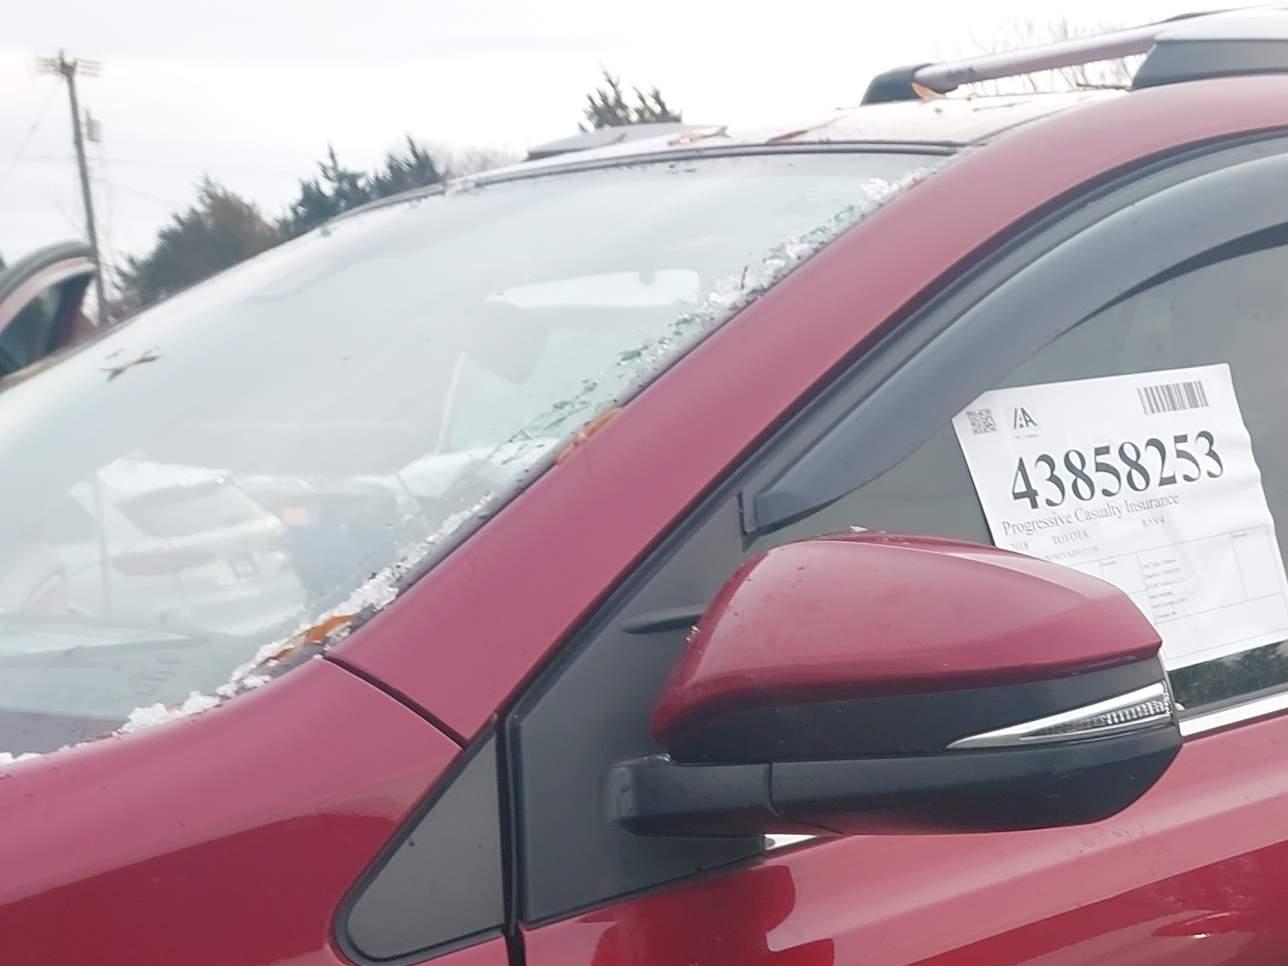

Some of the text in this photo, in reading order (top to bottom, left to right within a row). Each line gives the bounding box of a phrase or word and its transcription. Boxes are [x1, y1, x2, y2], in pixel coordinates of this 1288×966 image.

[1012, 431, 1223, 510] 43858253
[1002, 494, 1180, 536] Progressive Casualty Insurance
[1052, 530, 1089, 545] TOYOTA
